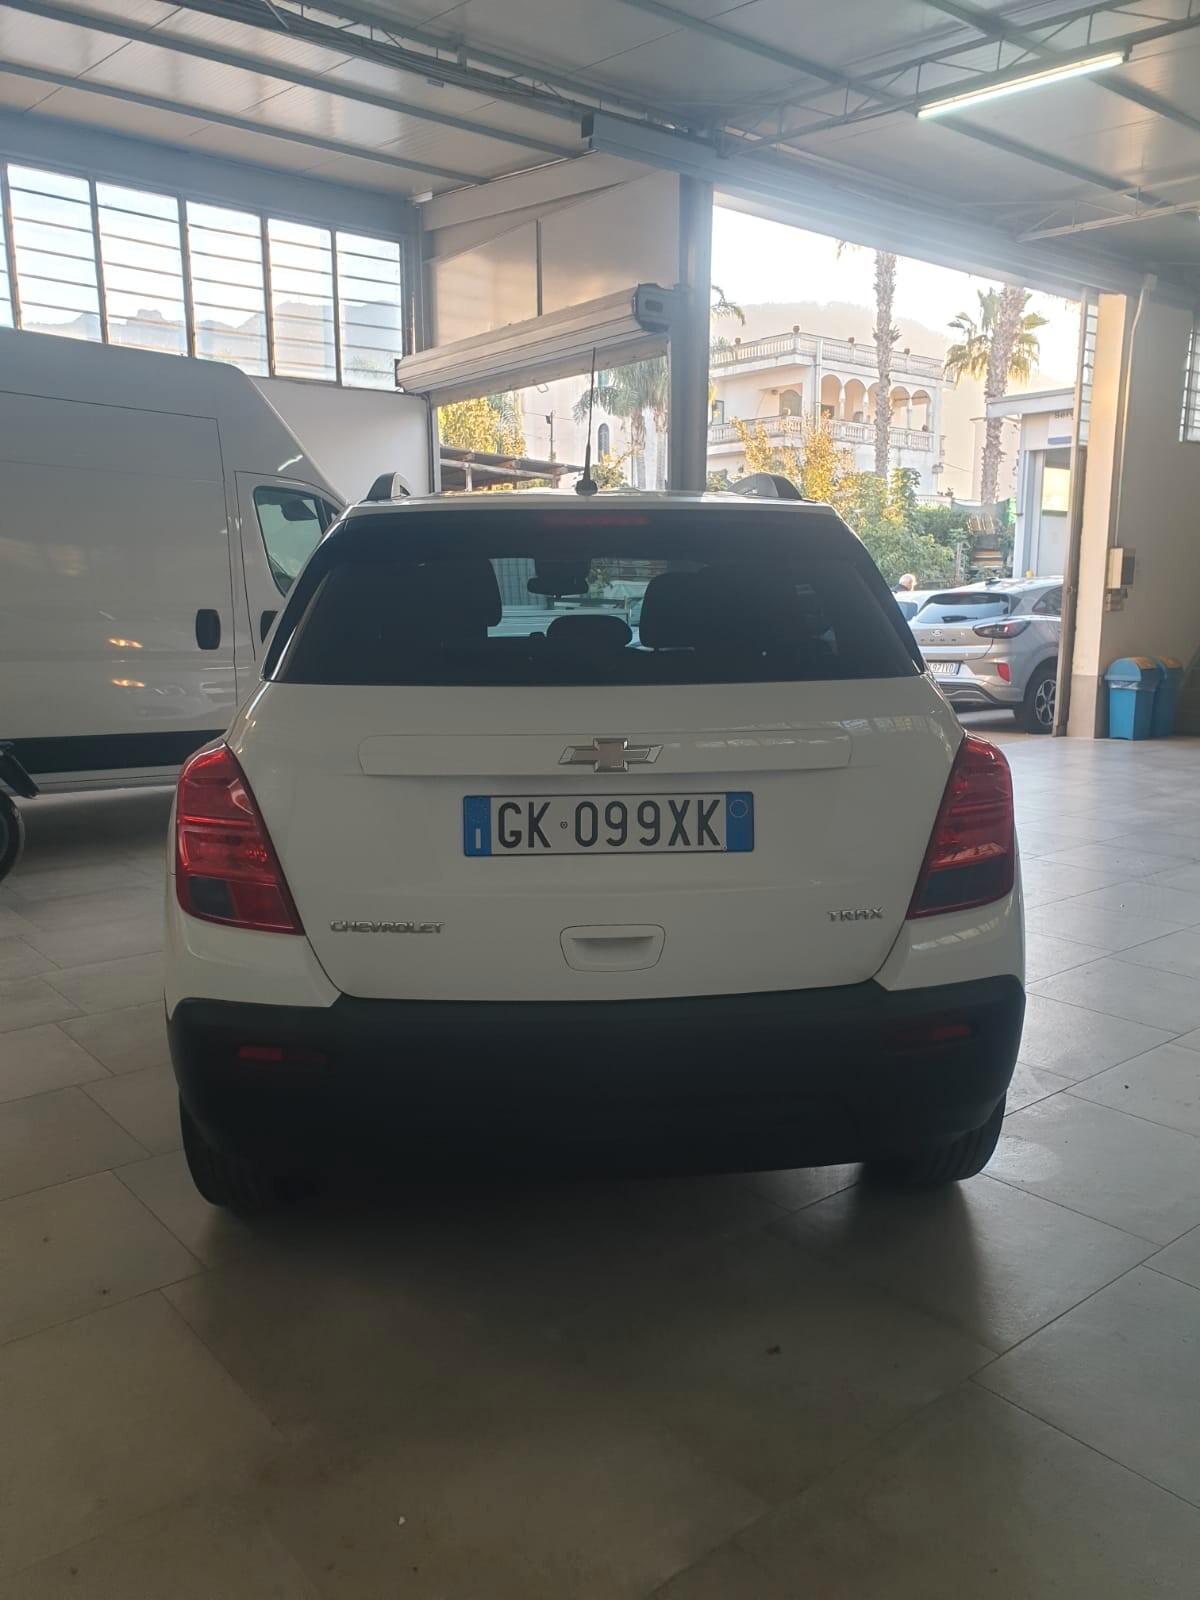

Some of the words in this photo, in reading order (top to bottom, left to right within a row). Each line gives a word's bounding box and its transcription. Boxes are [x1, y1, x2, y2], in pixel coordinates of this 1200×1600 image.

[498, 801, 552, 849] GK
[574, 799, 721, 847] 099XK
[827, 906, 883, 921] TRAX
[330, 920, 445, 934] CHEVROLET
